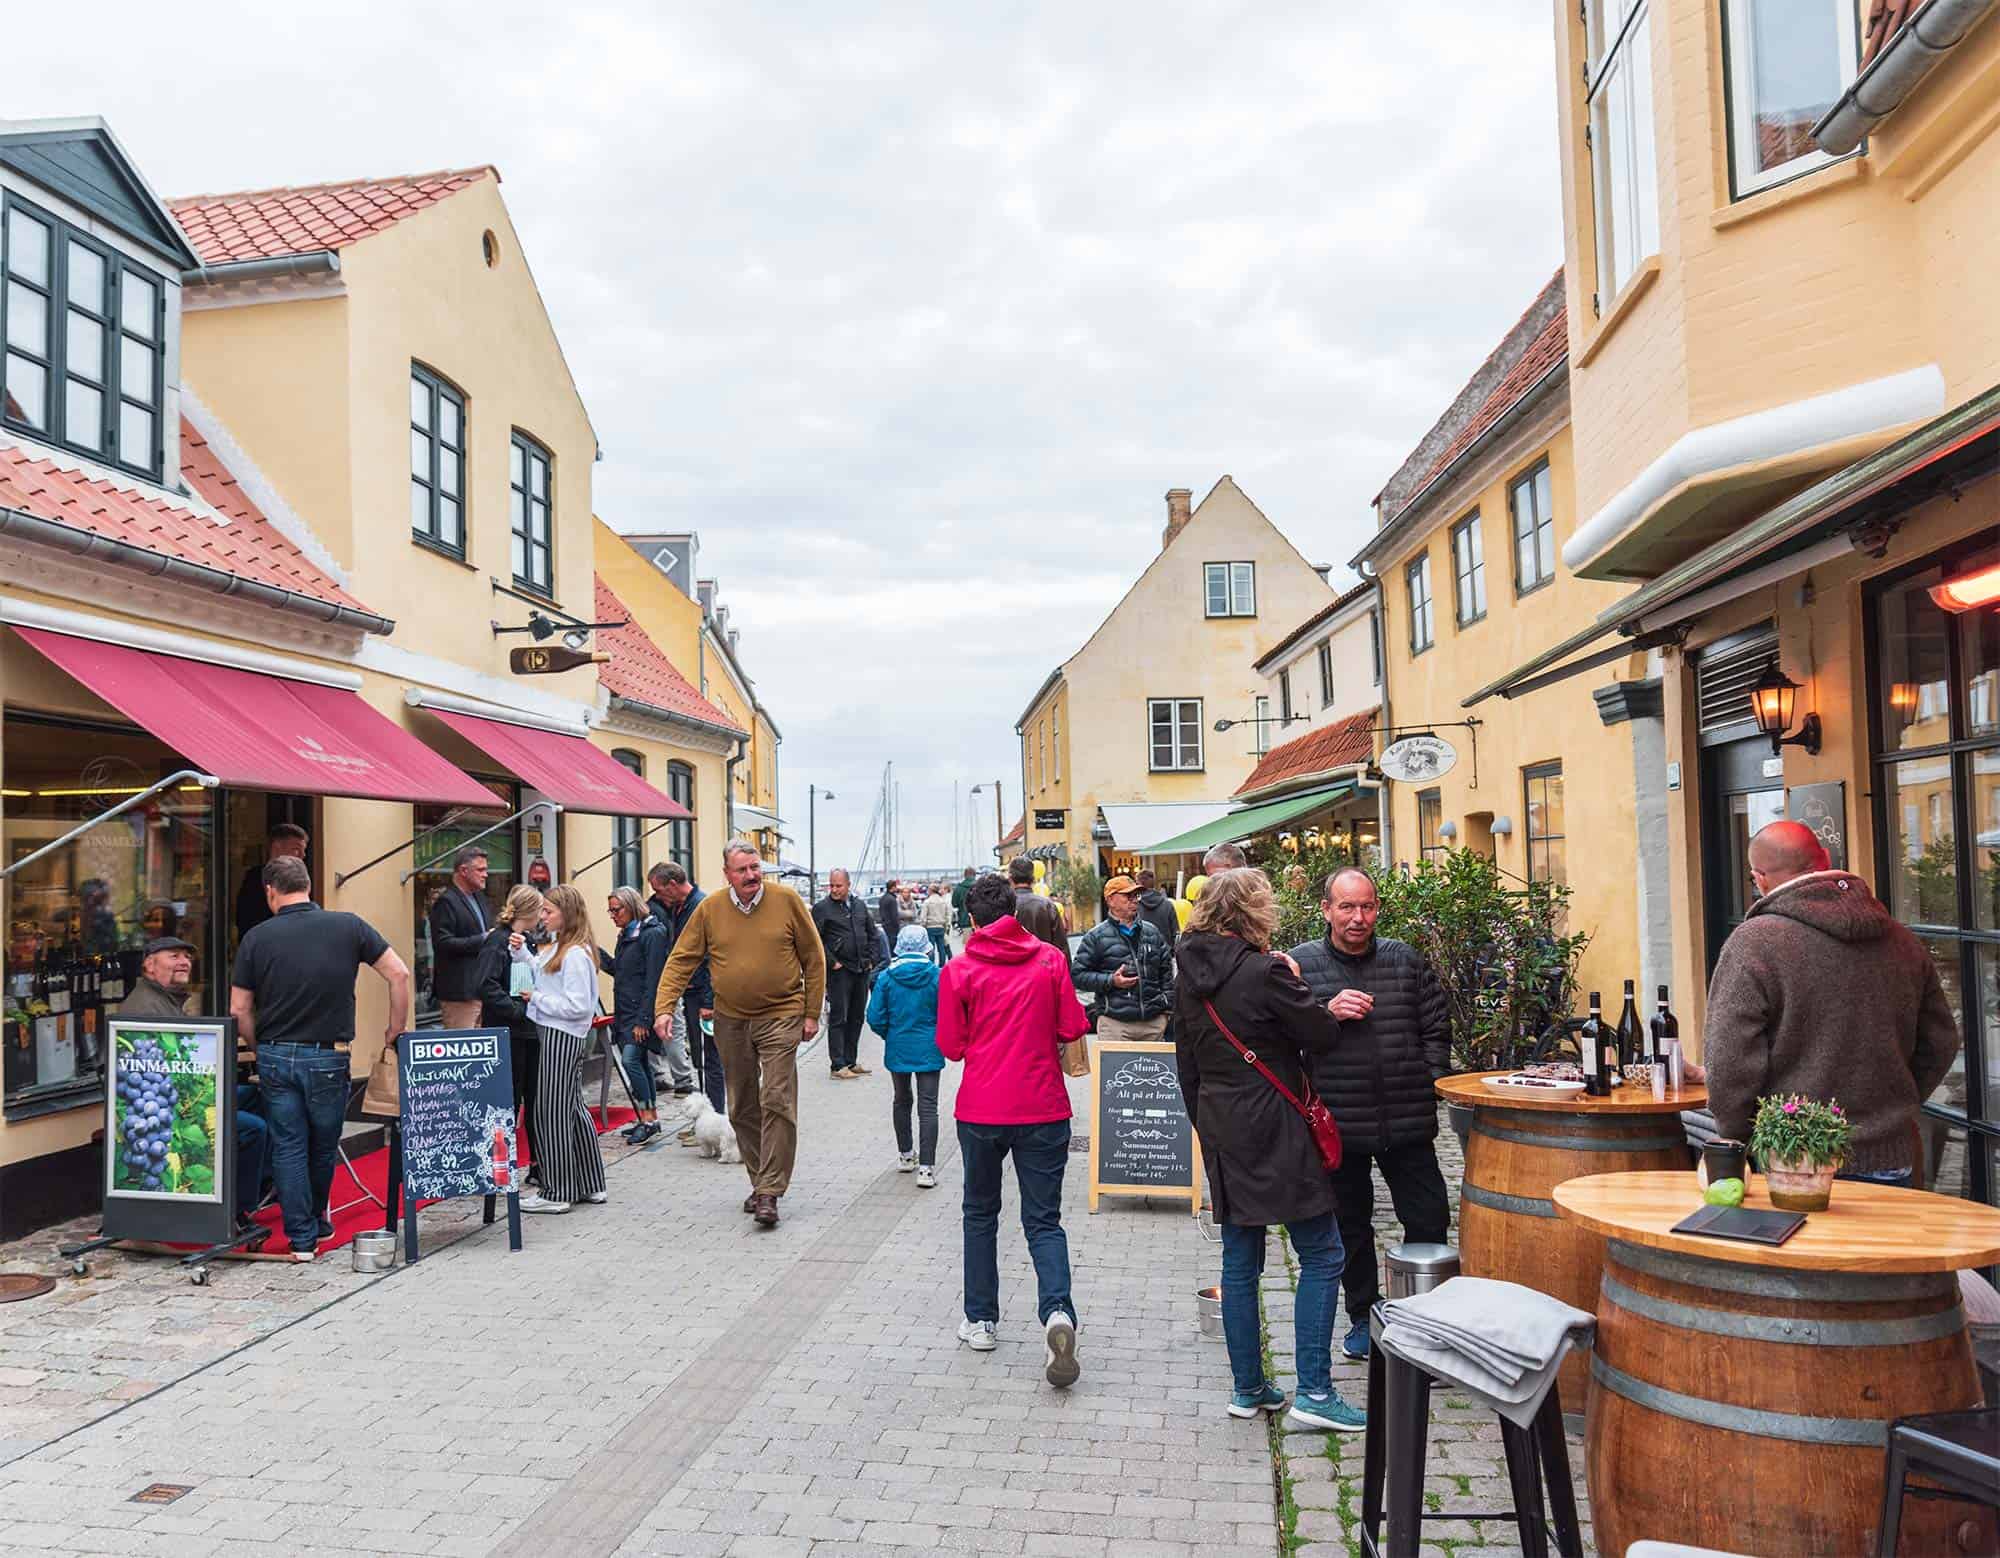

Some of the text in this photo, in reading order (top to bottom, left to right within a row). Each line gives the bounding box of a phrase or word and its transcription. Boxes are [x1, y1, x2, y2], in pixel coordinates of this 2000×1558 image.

[414, 1041, 494, 1060] BIONADE
[1132, 1063, 1161, 1073] Munk
[1116, 1090, 1176, 1101] Alt på et bræt
[1113, 1150, 1177, 1161] din egen brunch
